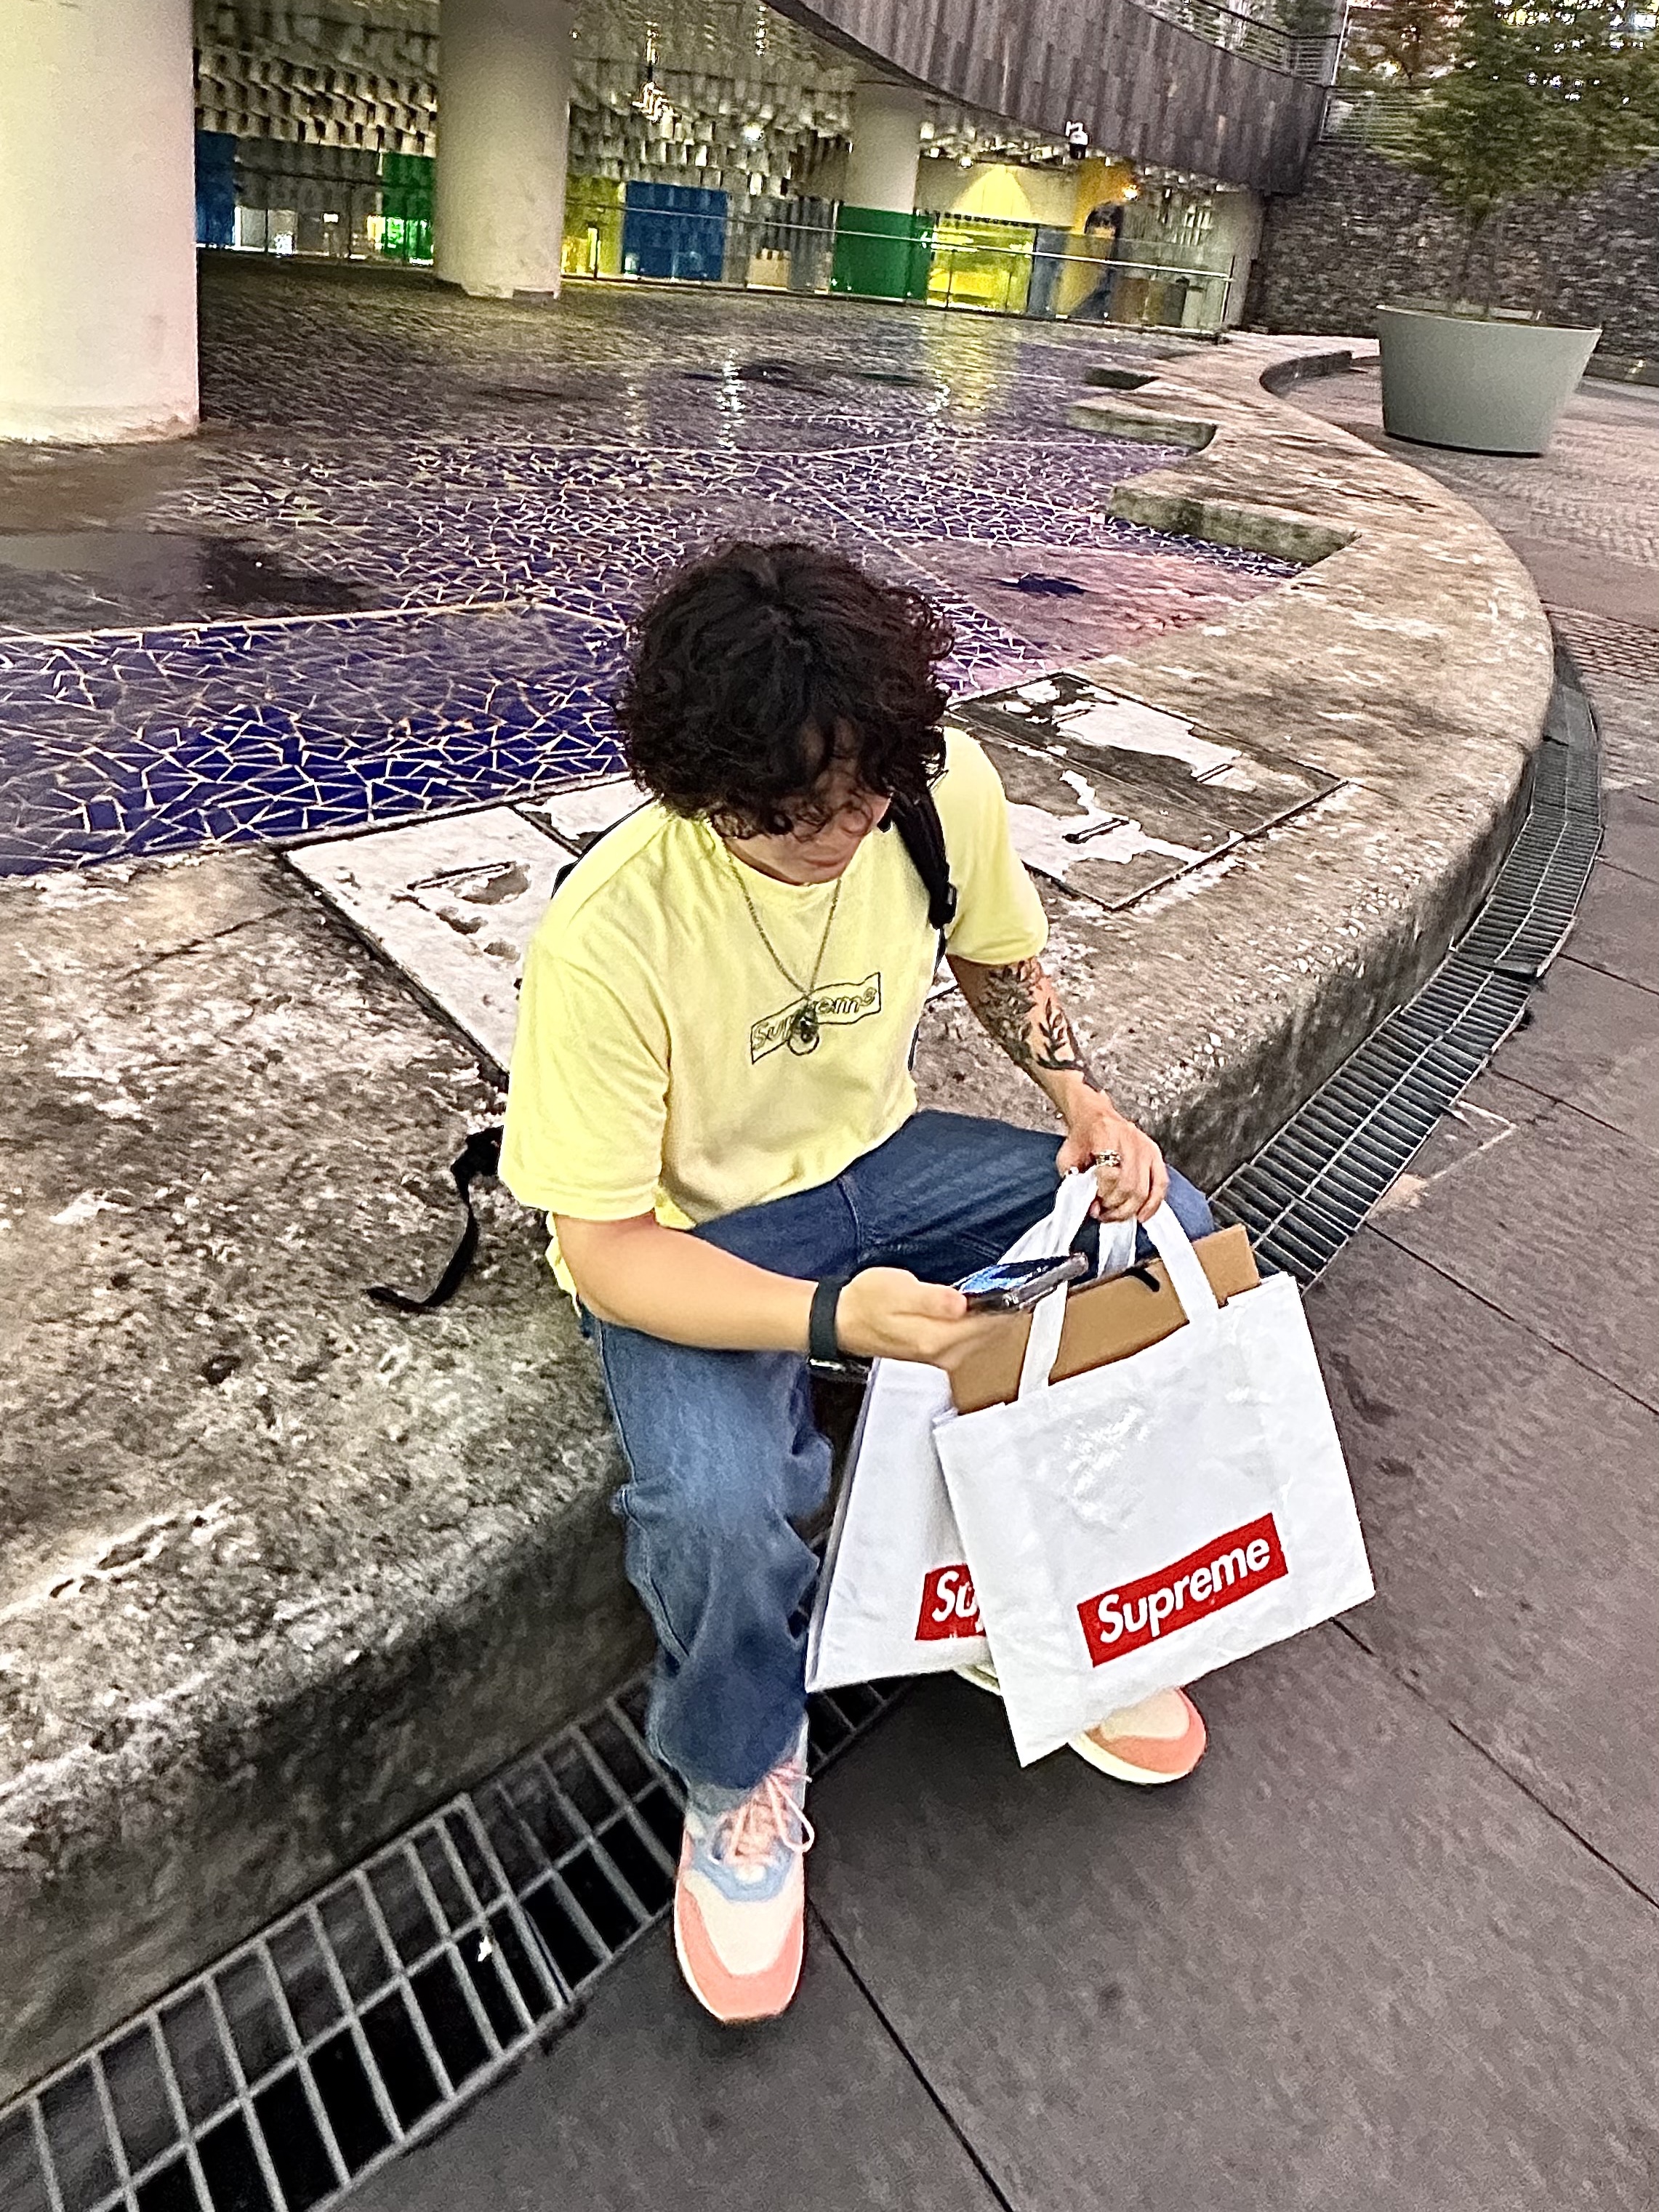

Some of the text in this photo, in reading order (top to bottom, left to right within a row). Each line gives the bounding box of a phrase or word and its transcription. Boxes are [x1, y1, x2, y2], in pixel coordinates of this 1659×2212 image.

[753, 986, 877, 1050] Sueme
[931, 1570, 984, 1633] Su
[1098, 1539, 1271, 1644] Supreme
